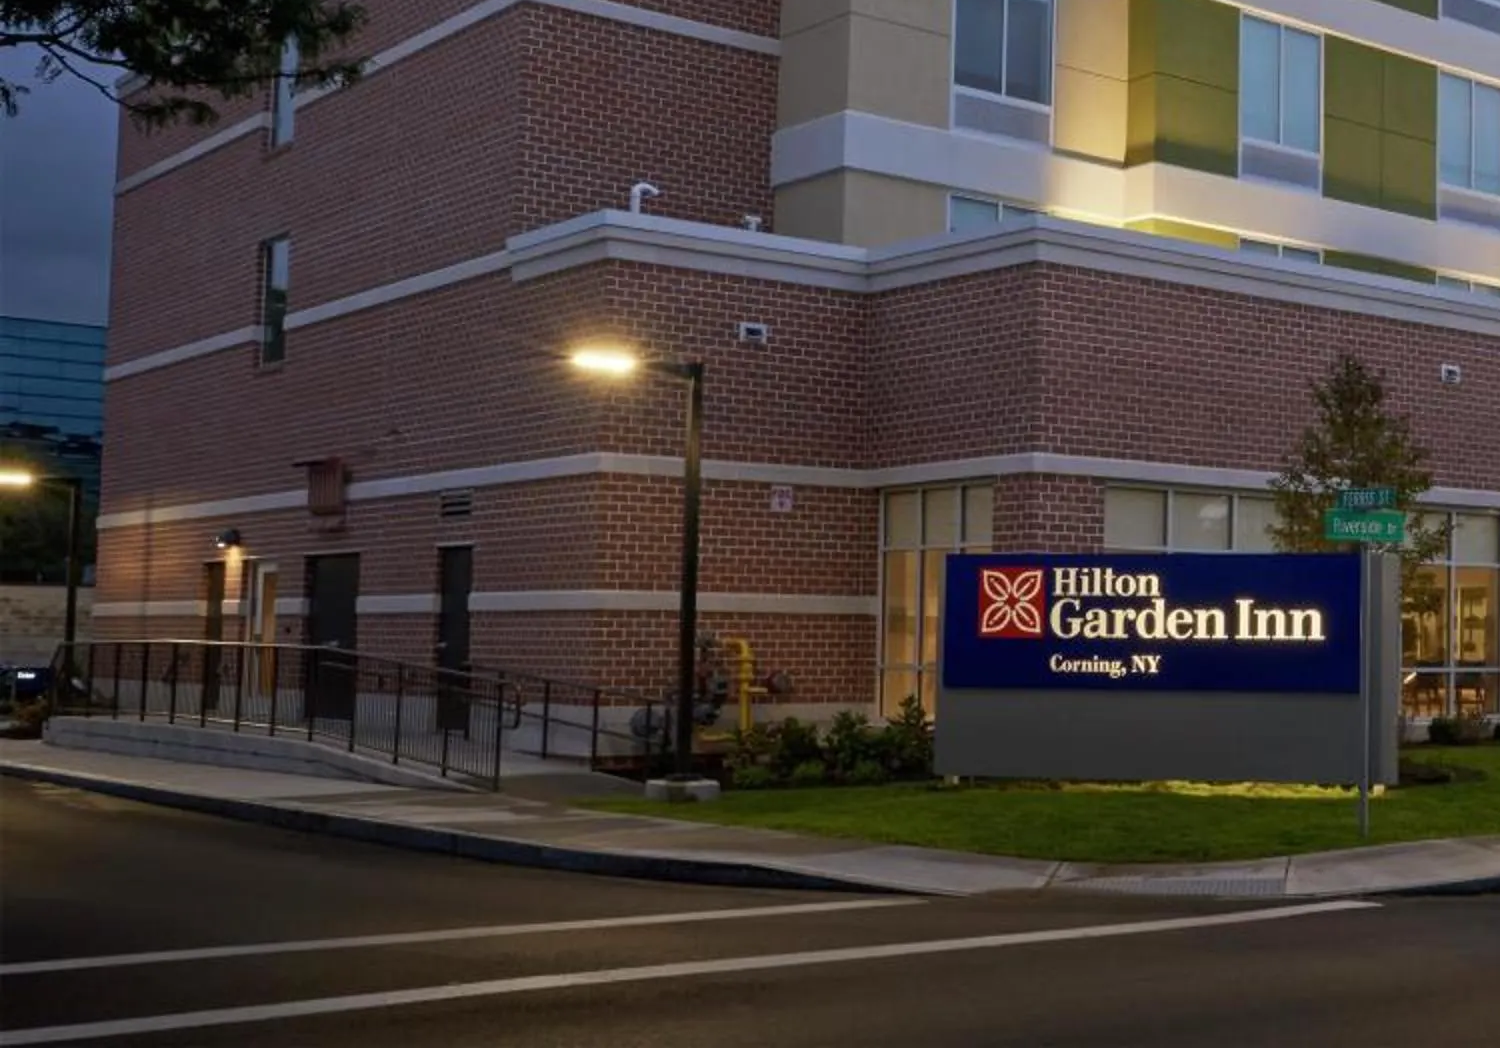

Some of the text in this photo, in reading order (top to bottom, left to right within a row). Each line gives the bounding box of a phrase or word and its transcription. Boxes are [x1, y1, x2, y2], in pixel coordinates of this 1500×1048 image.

[1053, 567, 1161, 597] Hilton
[1051, 598, 1326, 640] Garden Inn
[1050, 654, 1161, 679] Corning, NY
